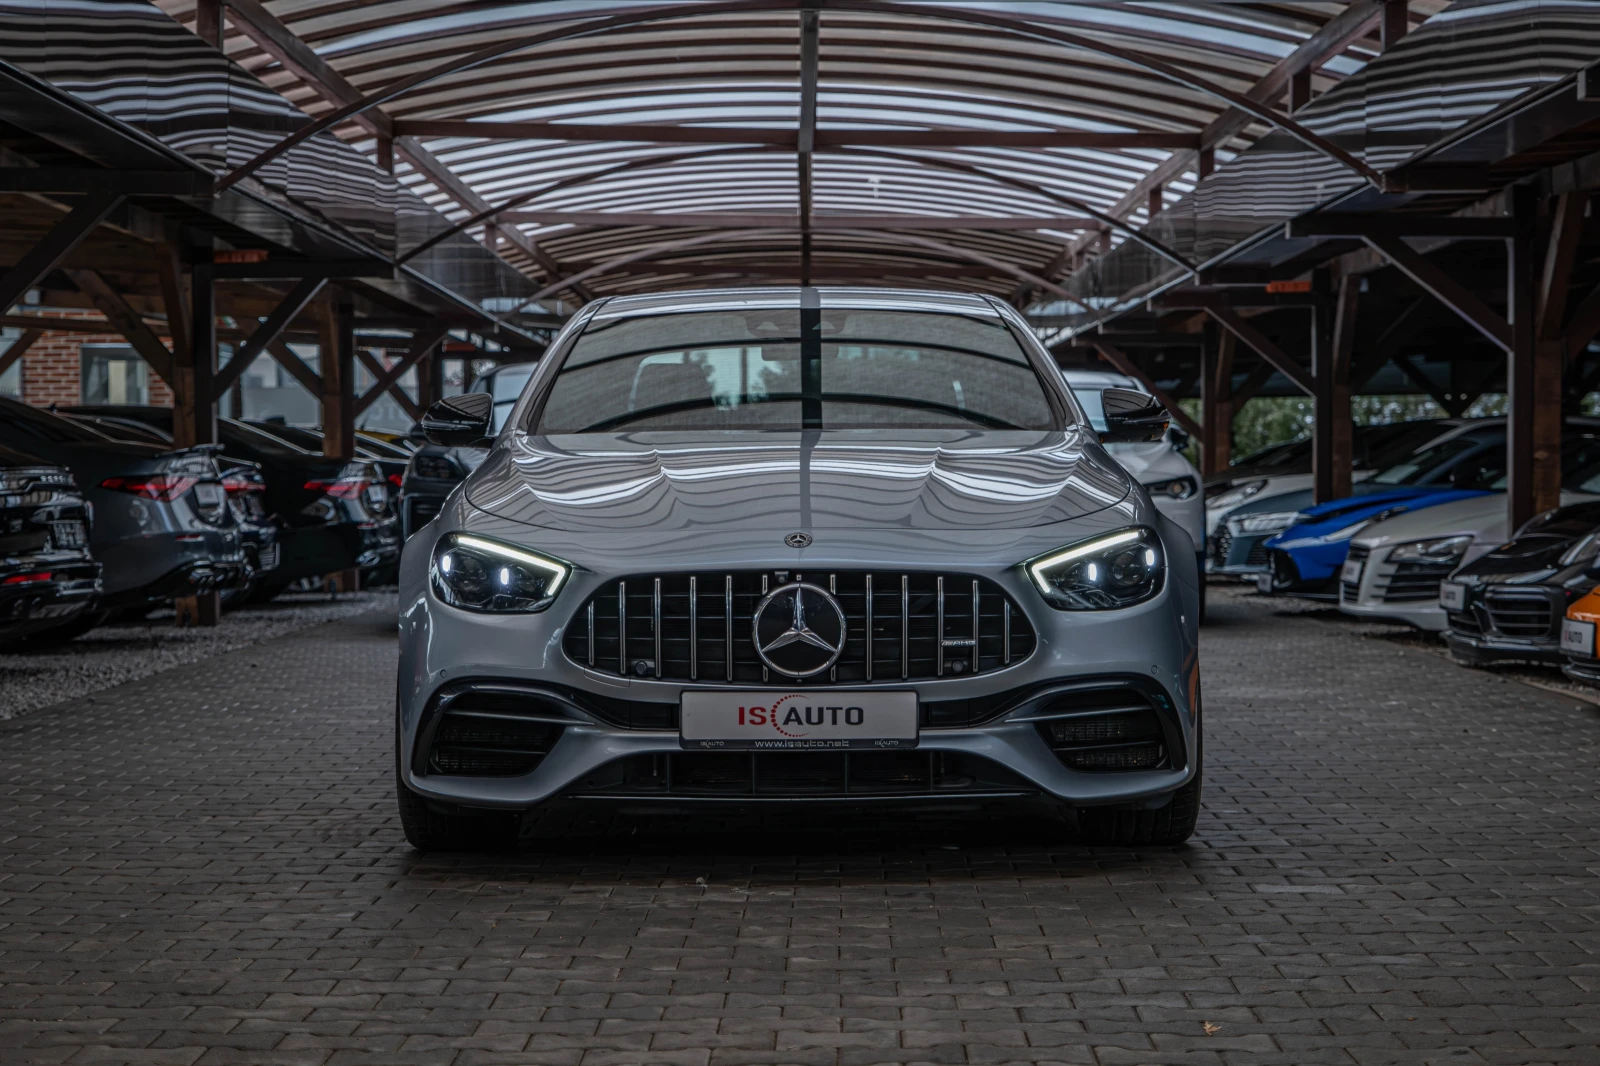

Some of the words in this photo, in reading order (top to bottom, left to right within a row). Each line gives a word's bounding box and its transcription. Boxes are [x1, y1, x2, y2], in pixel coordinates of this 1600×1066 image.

[738, 707, 767, 726] IS
[782, 707, 864, 726] AUTO
[755, 740, 849, 748] www.isauto.net
